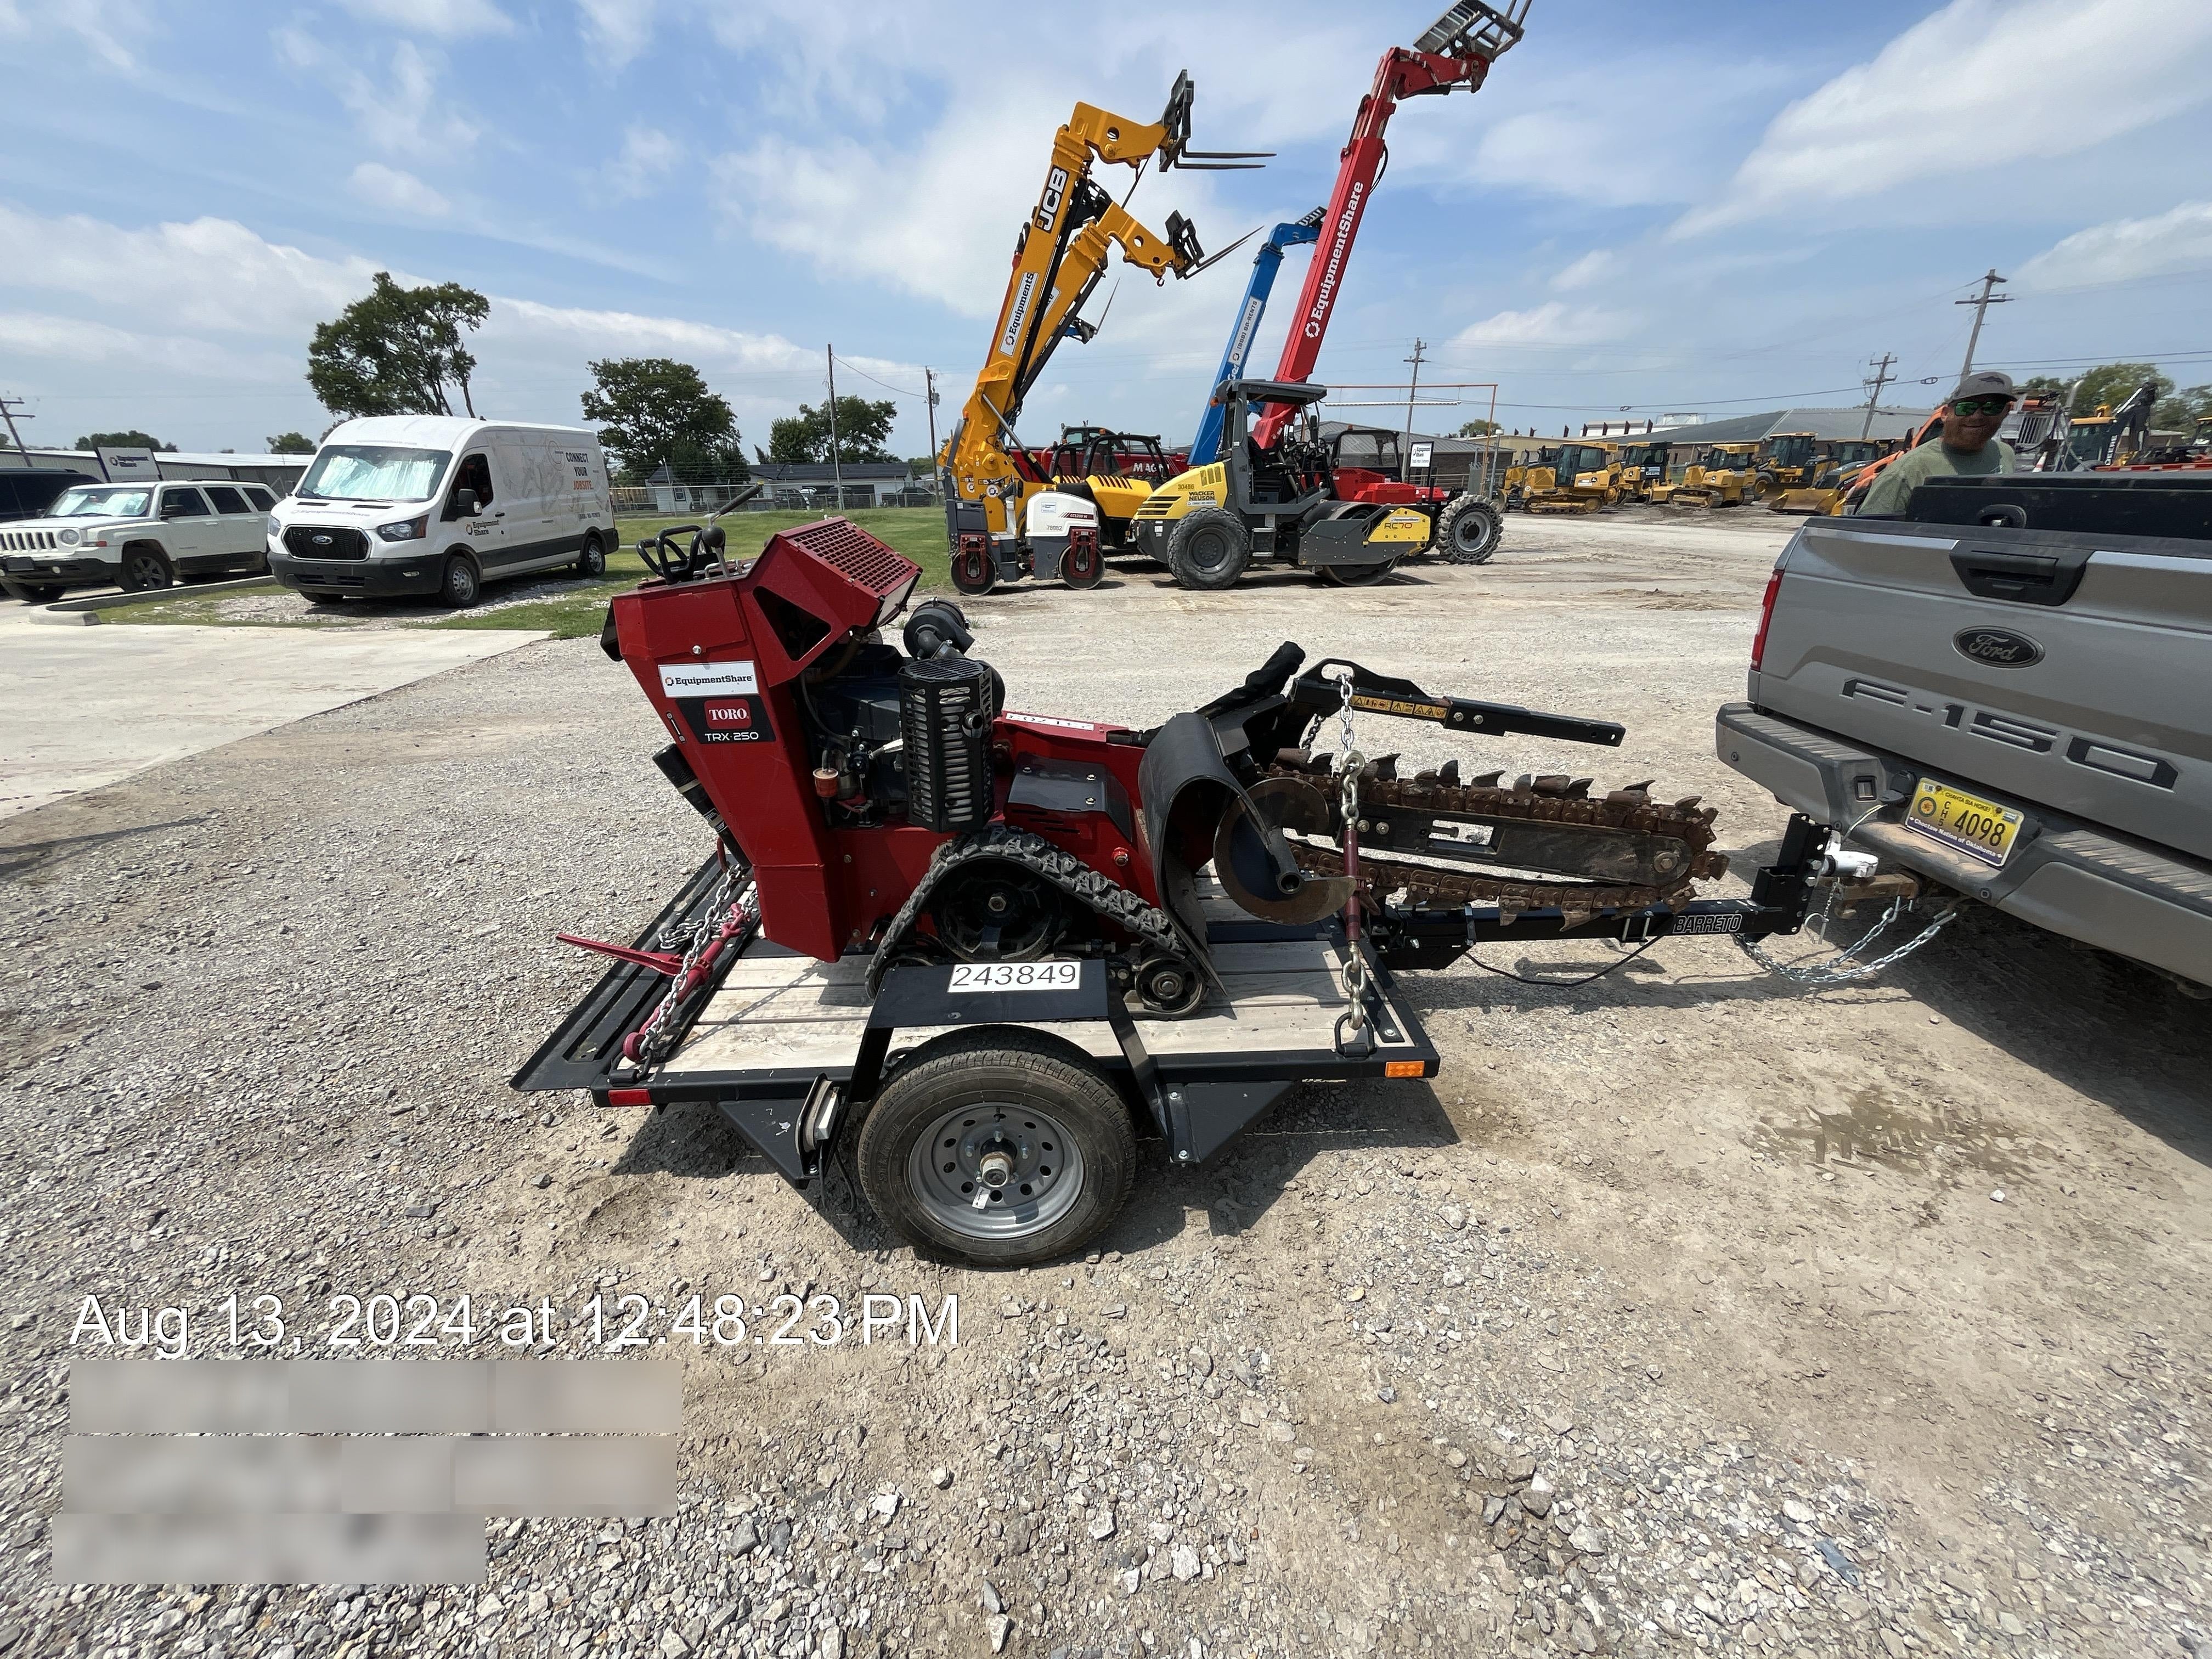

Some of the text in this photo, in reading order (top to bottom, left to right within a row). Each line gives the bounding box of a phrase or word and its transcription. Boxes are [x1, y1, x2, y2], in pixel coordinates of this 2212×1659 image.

[1039, 168, 1067, 231] JCB
[1311, 182, 1363, 320] EquipmentShare
[566, 452, 589, 463] CONNECT
[574, 466, 588, 476] YOUR
[574, 480, 594, 490] JOBSITE.
[1968, 634, 2020, 661] Ford
[675, 675, 752, 686] EquipmentShare
[708, 708, 747, 720] TORO
[1838, 677, 2181, 793] F-150
[1914, 819, 1938, 833] Choctaw
[1938, 828, 1959, 841] Nation
[1965, 840, 1997, 857] Oklahoma
[1953, 810, 2006, 847] 4098
[1673, 914, 1742, 934] BARRETO
[952, 964, 1076, 986] 243849
